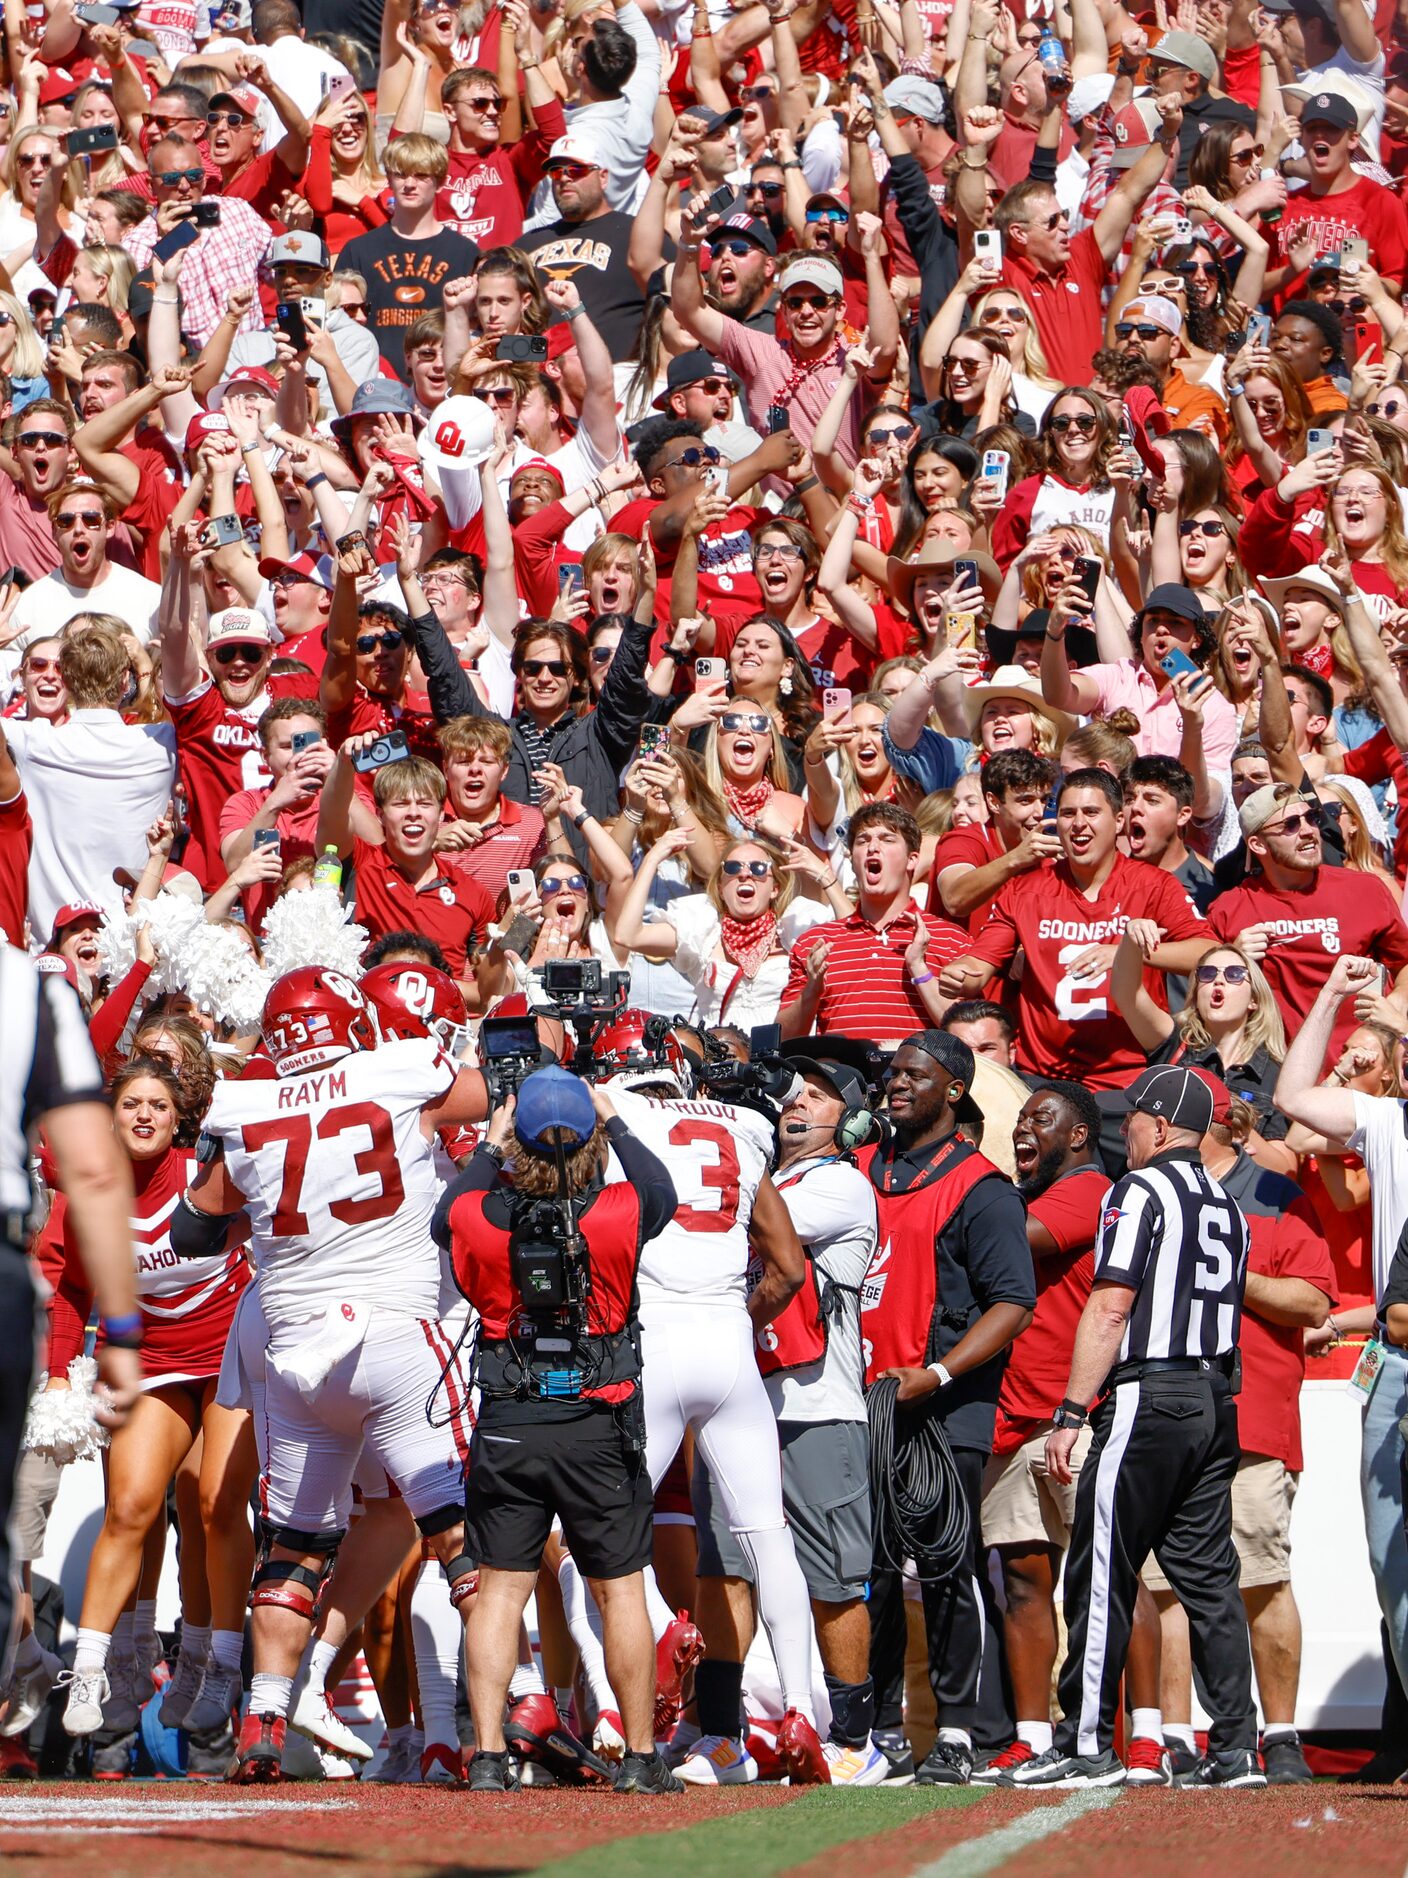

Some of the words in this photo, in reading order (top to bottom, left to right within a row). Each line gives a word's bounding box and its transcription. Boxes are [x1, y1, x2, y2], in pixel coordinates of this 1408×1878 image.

[1116, 123, 1128, 143] OU
[374, 252, 449, 283] TEXAS
[532, 239, 612, 273] TEXAS
[435, 420, 467, 457] OU
[221, 622, 249, 634] LIGHT
[1038, 916, 1130, 942] SOONERS
[1321, 932, 1340, 954] OU
[321, 971, 364, 1009] OU
[398, 971, 436, 1019] OU
[1054, 944, 1108, 1020] 2
[274, 1022, 309, 1049] 73
[280, 1052, 326, 1072] SOONERS
[279, 1070, 347, 1109] RAYM
[242, 1101, 405, 1237] 73
[930, 1142, 956, 1167] ESPN
[669, 1118, 740, 1232] 3
[1195, 1204, 1233, 1292] S
[341, 1303, 356, 1321] OU
